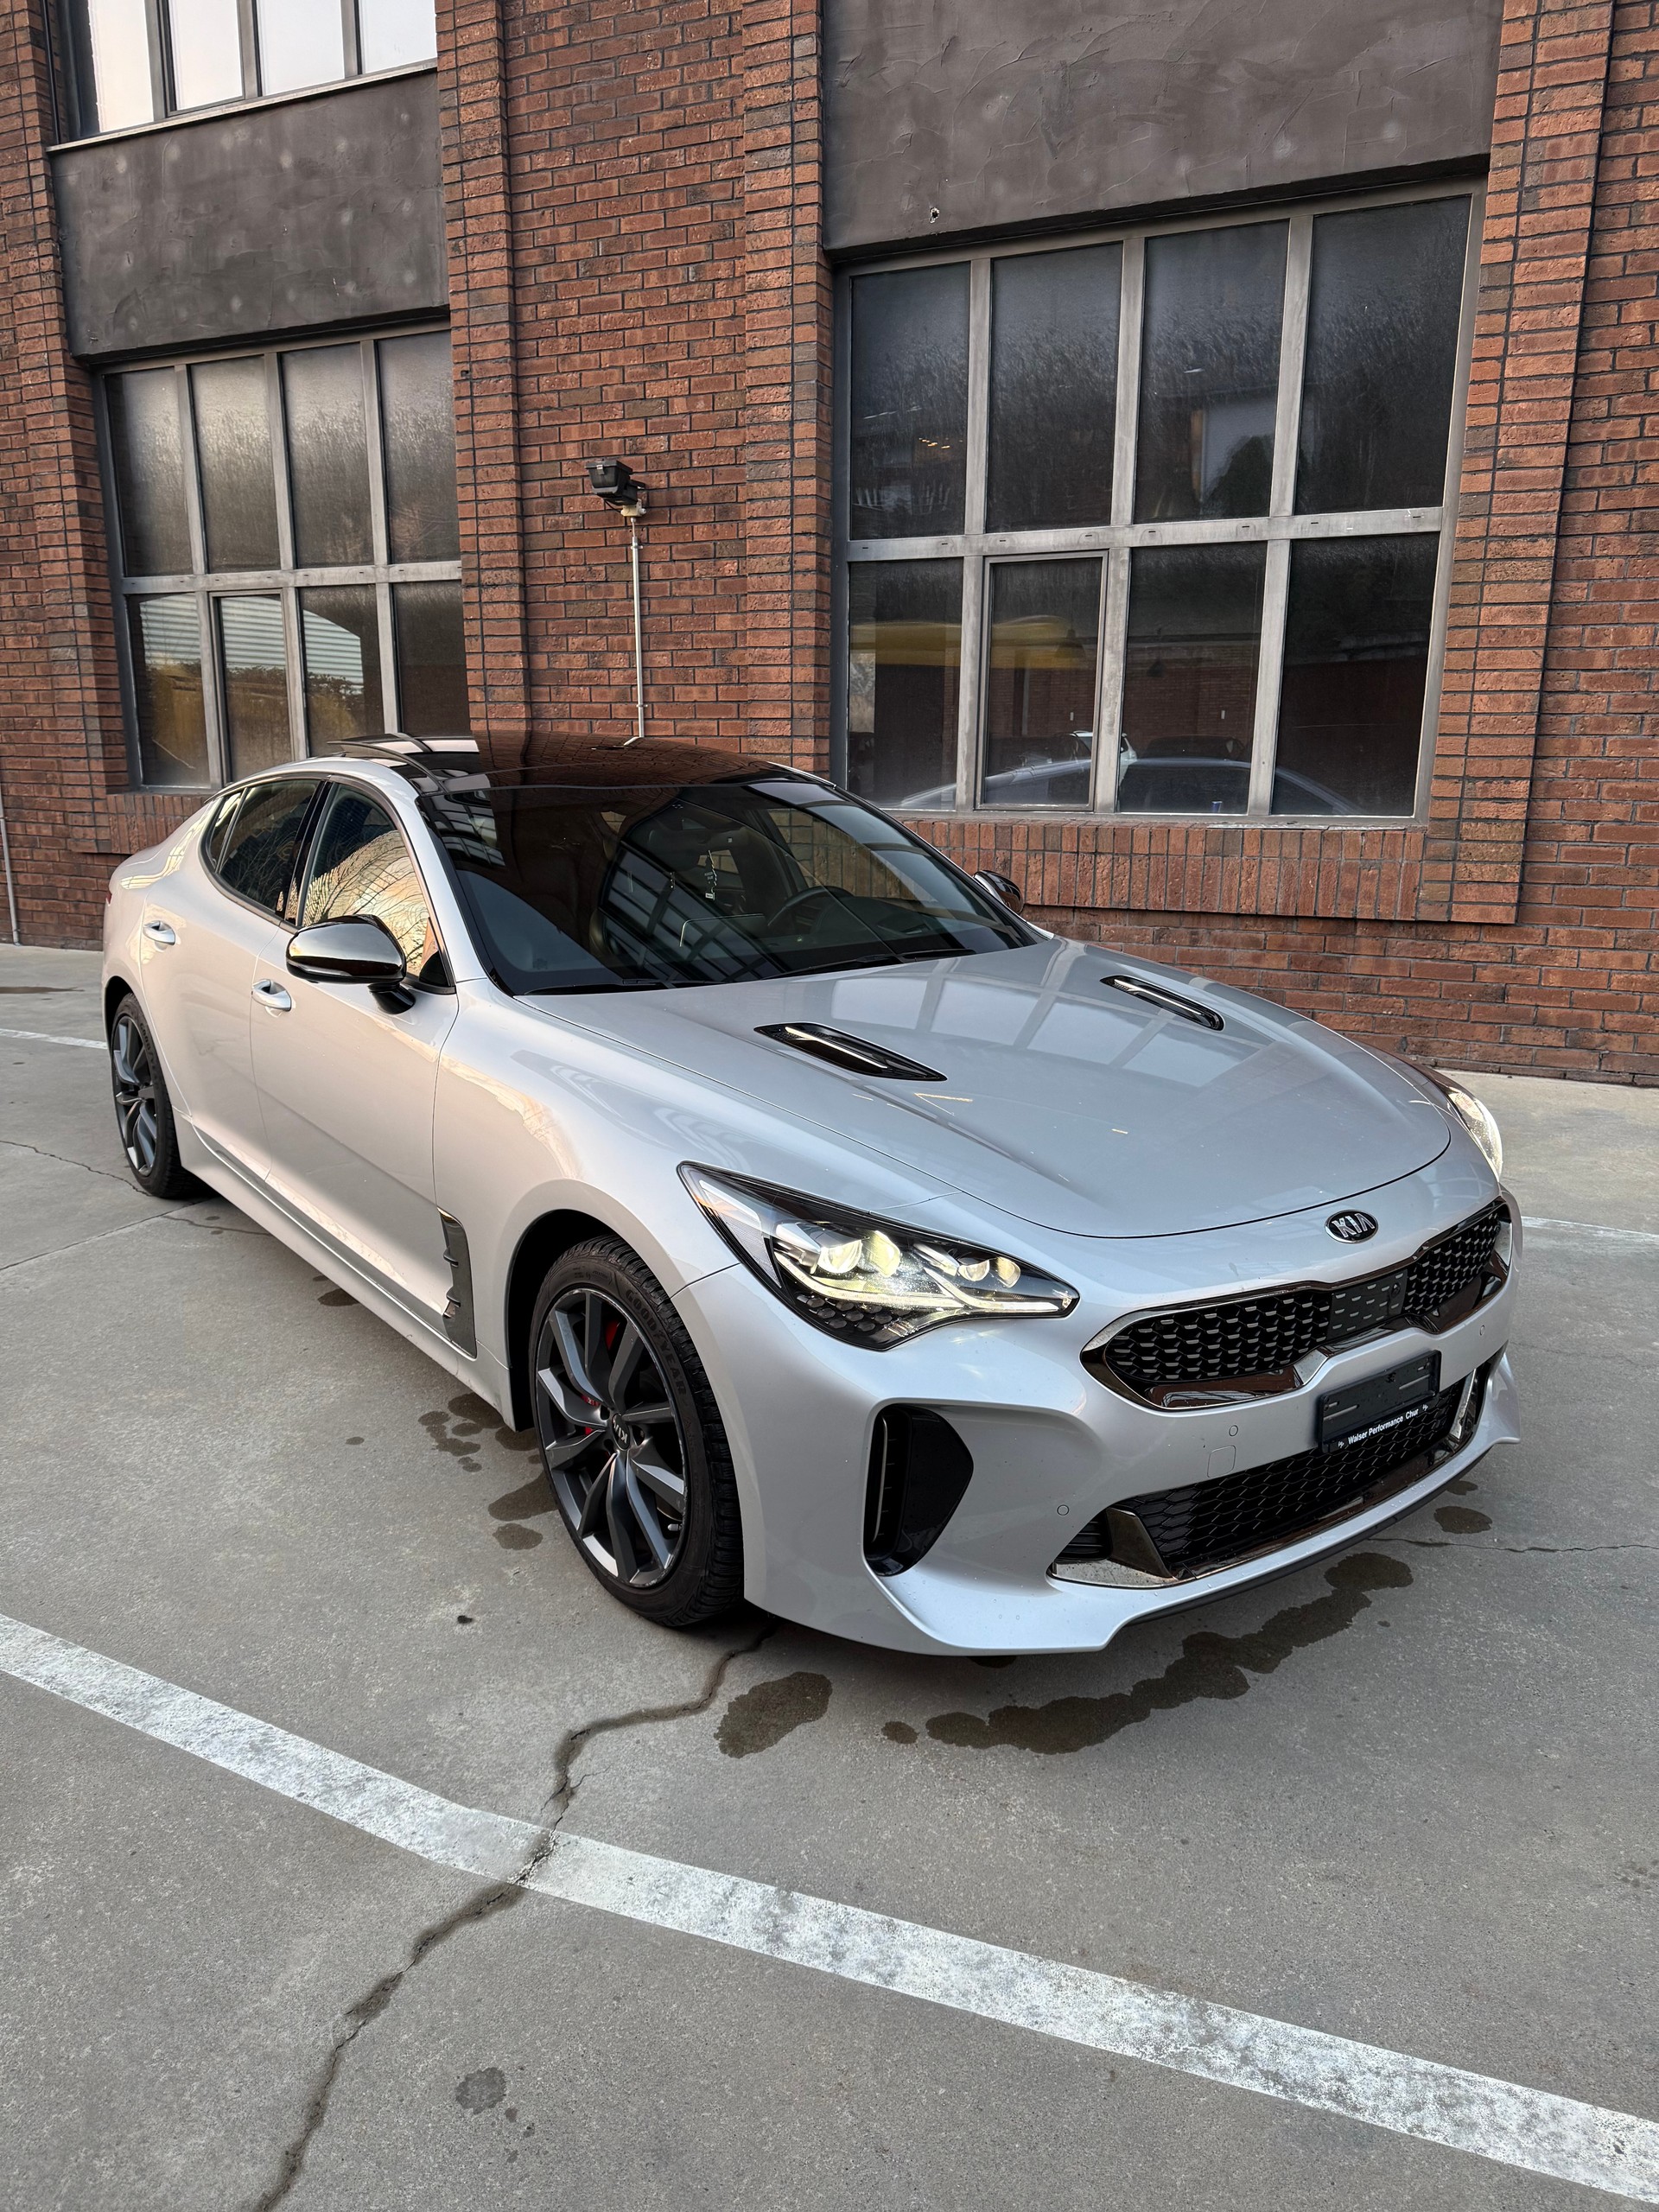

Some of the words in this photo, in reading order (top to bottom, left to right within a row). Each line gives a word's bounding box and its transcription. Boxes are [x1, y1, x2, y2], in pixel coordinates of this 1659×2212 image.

[1332, 1212, 1376, 1238] KIA
[625, 1288, 688, 1396] GOODYEAR
[613, 1421, 628, 1446] KIA
[1348, 1431, 1368, 1445] Walser
[1369, 1415, 1404, 1436] Performance
[1405, 1408, 1419, 1420] Chur
